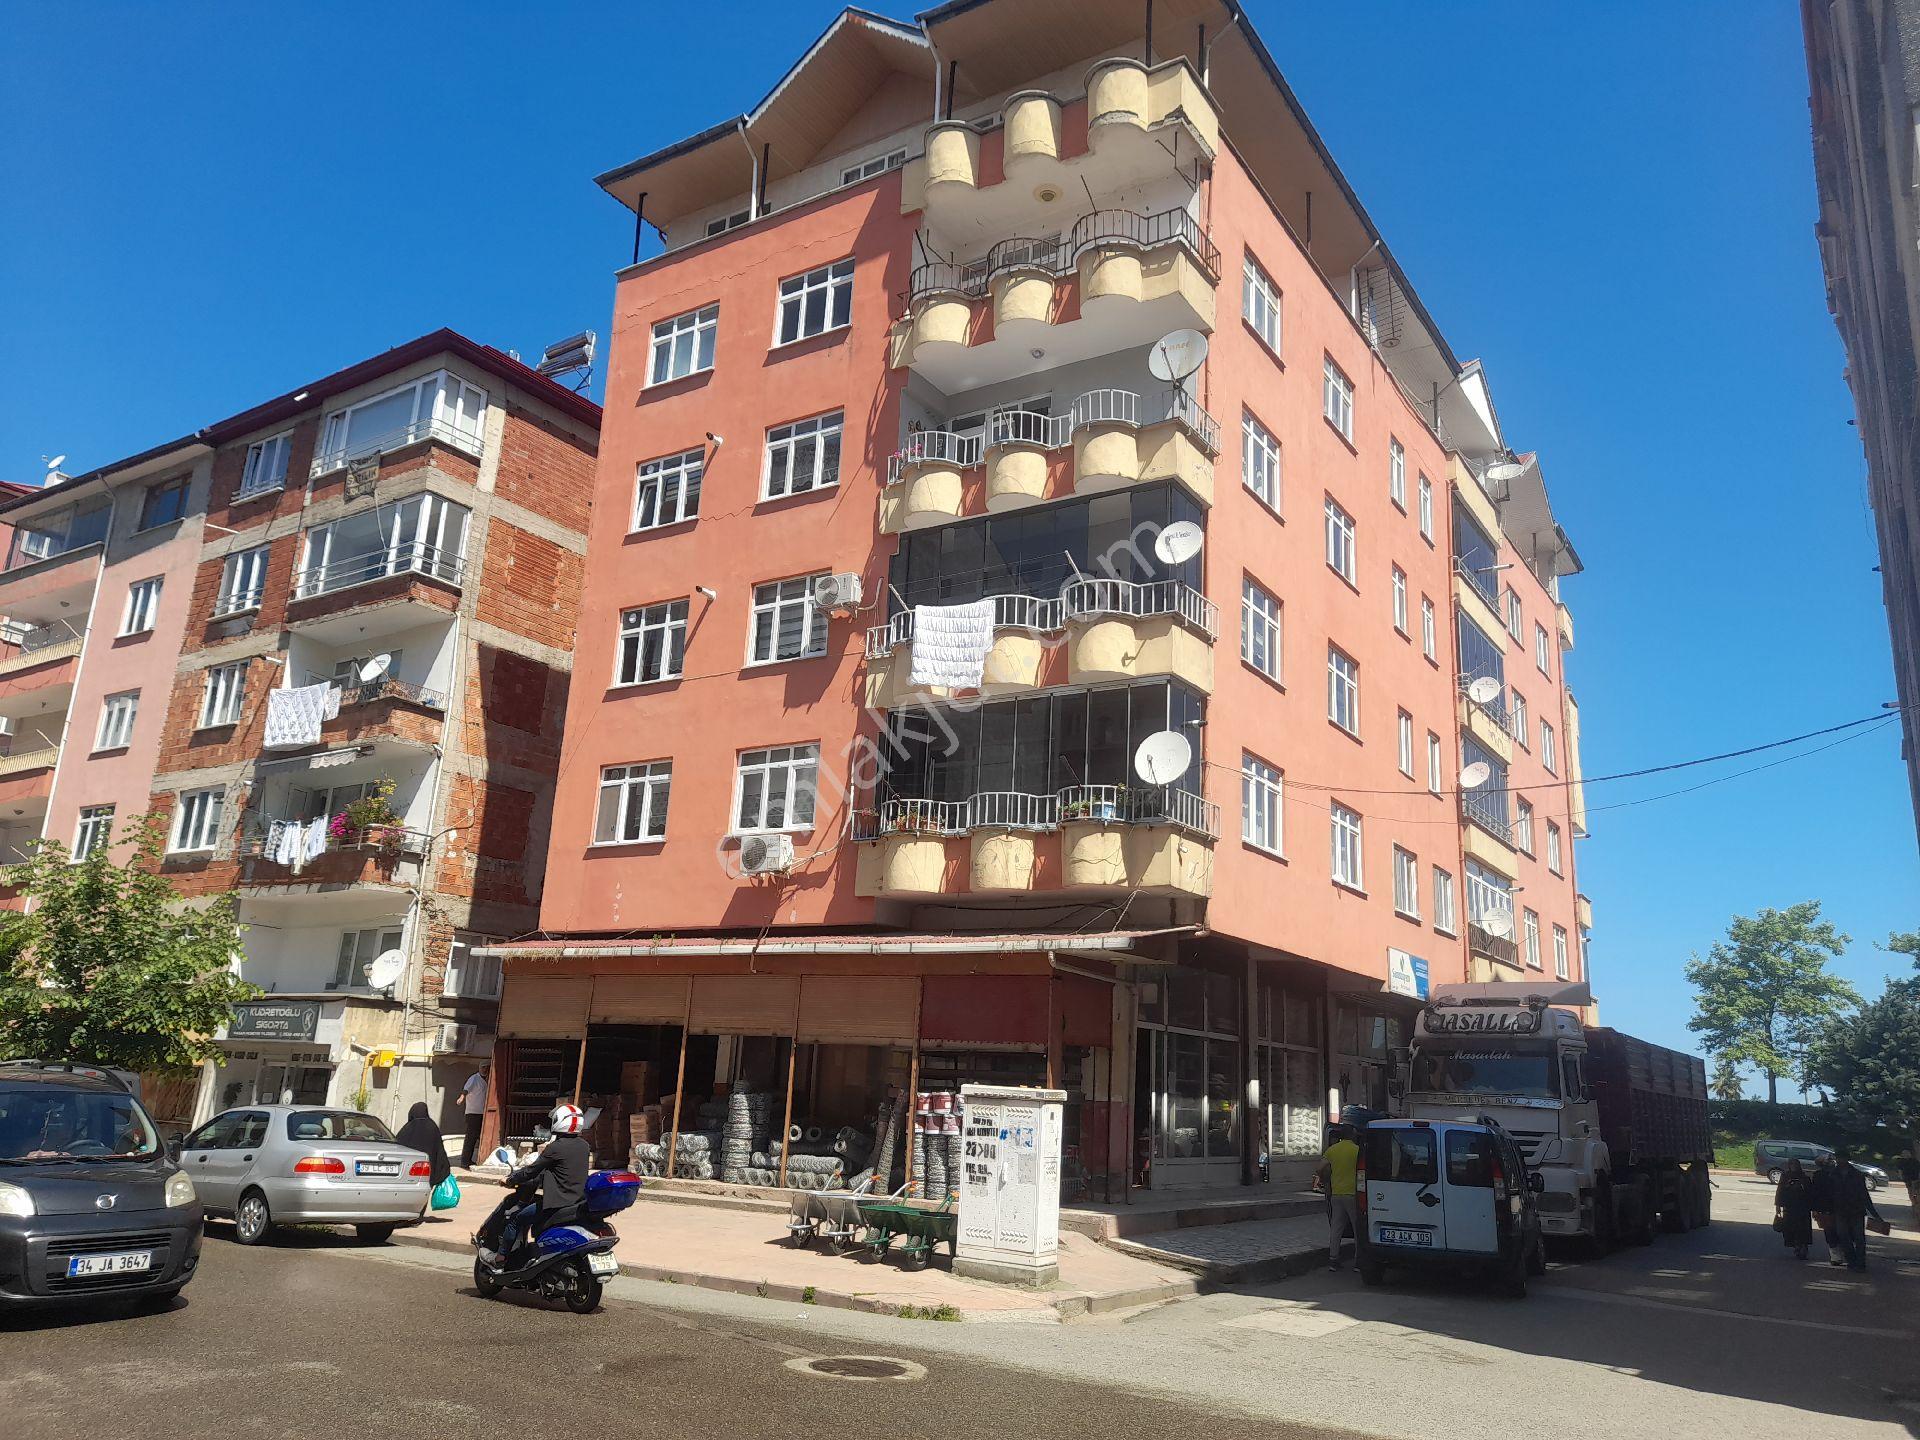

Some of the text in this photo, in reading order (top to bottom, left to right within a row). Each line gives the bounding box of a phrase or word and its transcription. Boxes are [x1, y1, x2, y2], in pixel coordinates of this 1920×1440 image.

[1416, 1233, 1430, 1242] 105
[78, 1255, 148, 1273] 34 JA 3647
